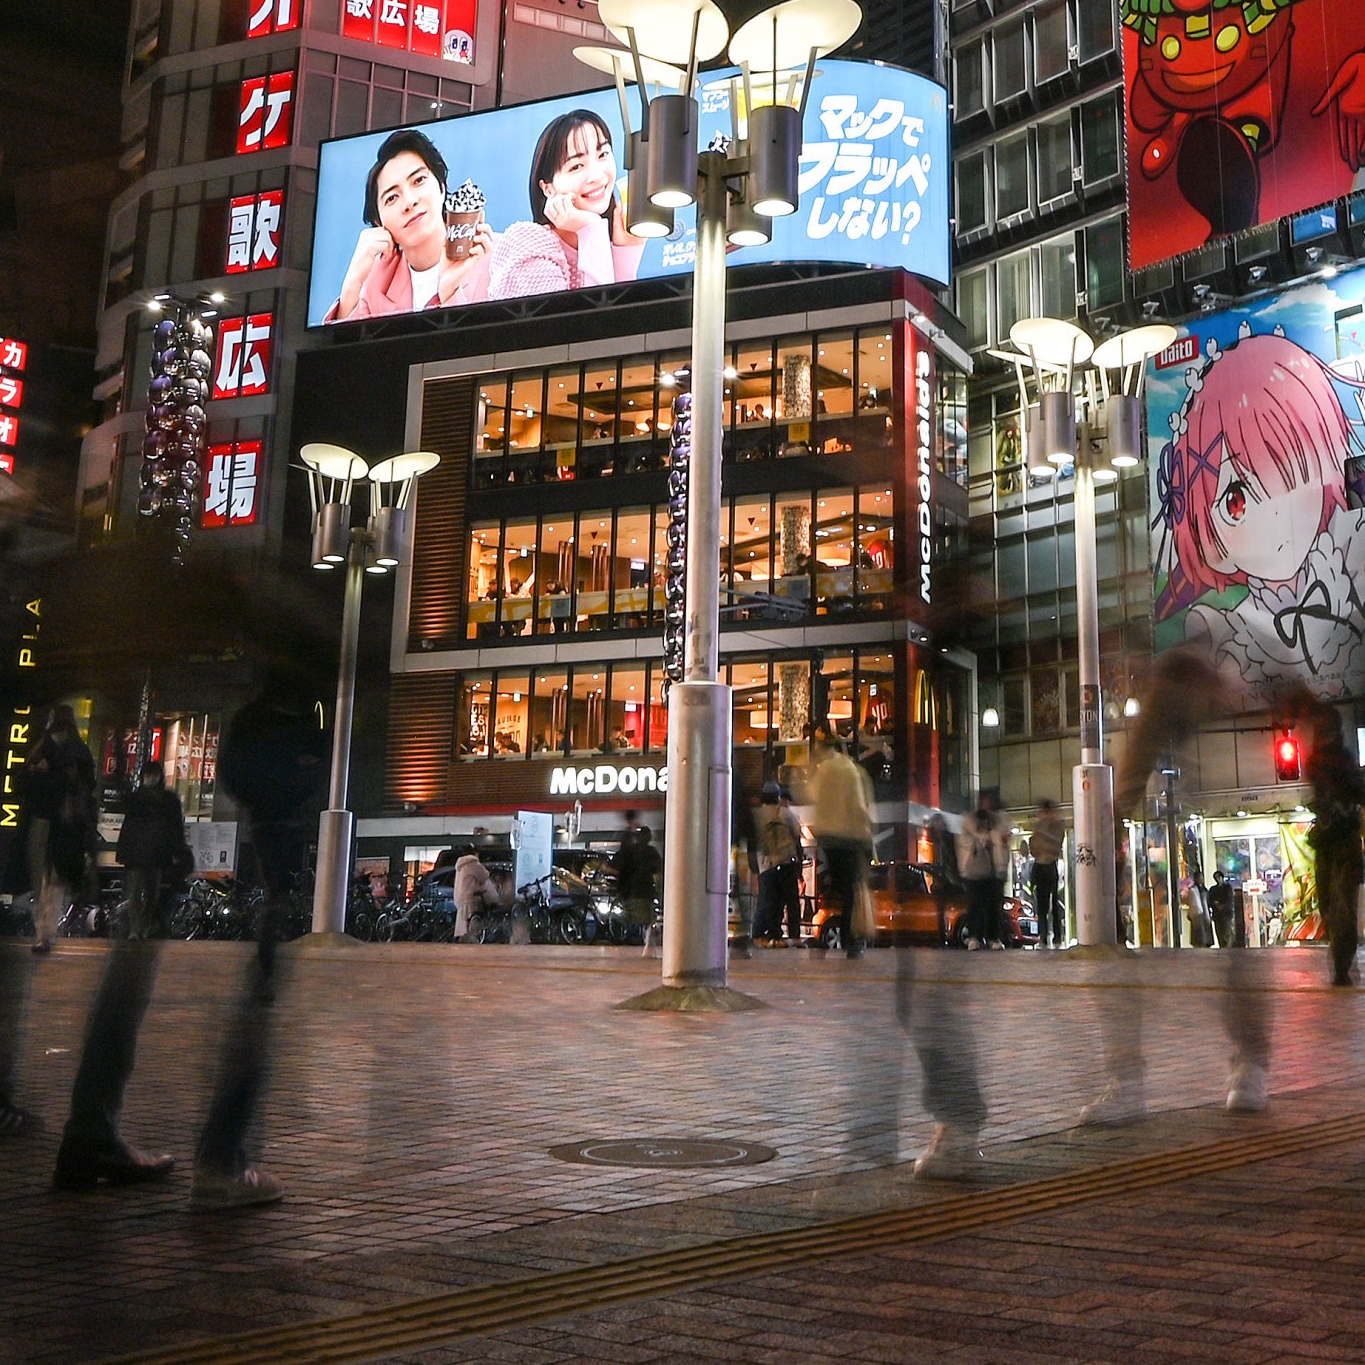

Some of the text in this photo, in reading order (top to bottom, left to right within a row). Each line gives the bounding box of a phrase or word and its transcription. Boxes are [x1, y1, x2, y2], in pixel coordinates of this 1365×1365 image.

[818, 93, 926, 148] マックで
[798, 141, 933, 197] フラッペ
[806, 196, 922, 246] しない?
